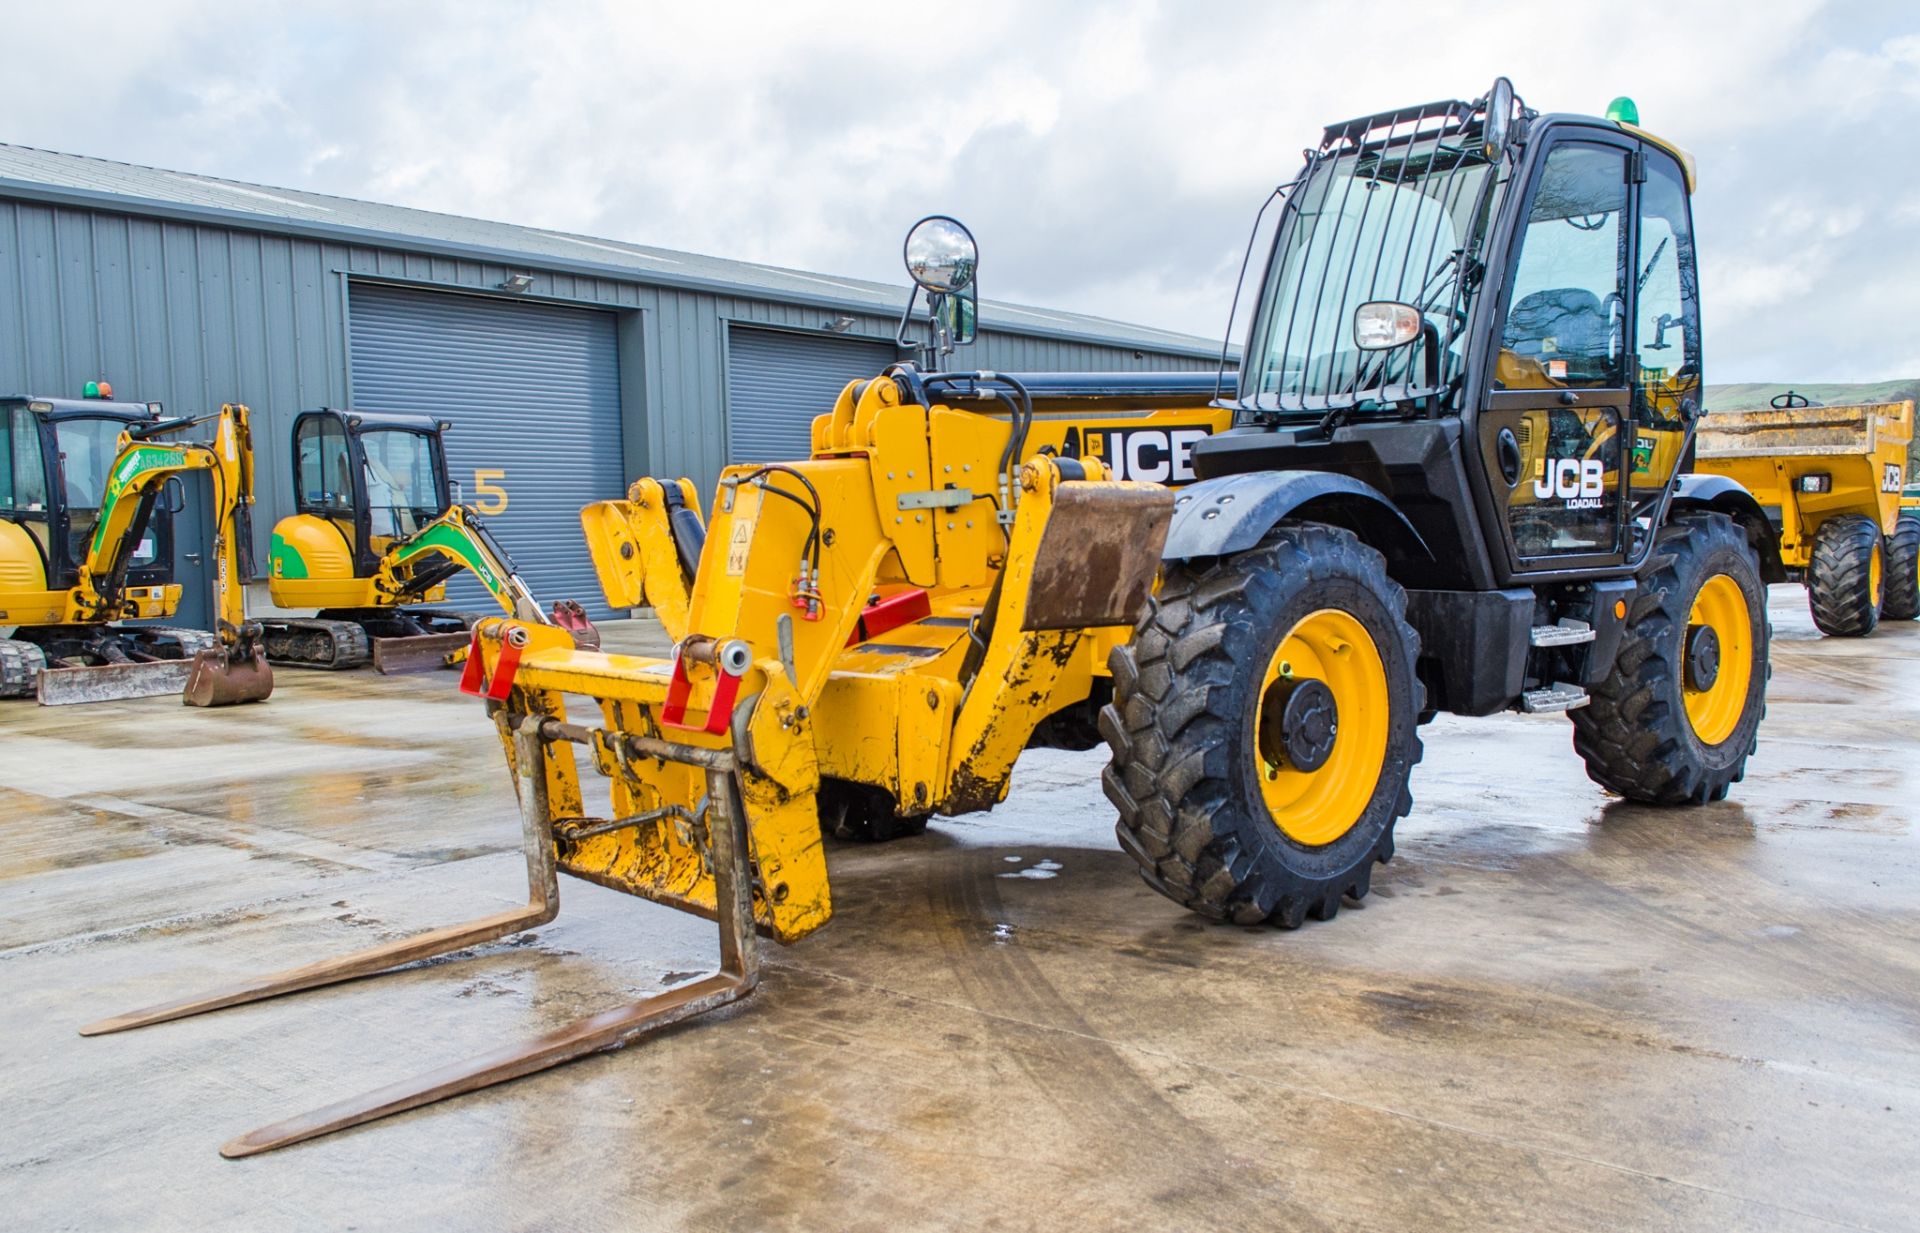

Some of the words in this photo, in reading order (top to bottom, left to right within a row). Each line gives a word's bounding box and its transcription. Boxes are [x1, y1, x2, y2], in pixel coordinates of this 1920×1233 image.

[1110, 430, 1208, 482] JCB
[475, 470, 508, 515] 5
[1534, 458, 1603, 499] JCB
[1882, 465, 1900, 491] JCB
[1567, 499, 1603, 509] LOADALL
